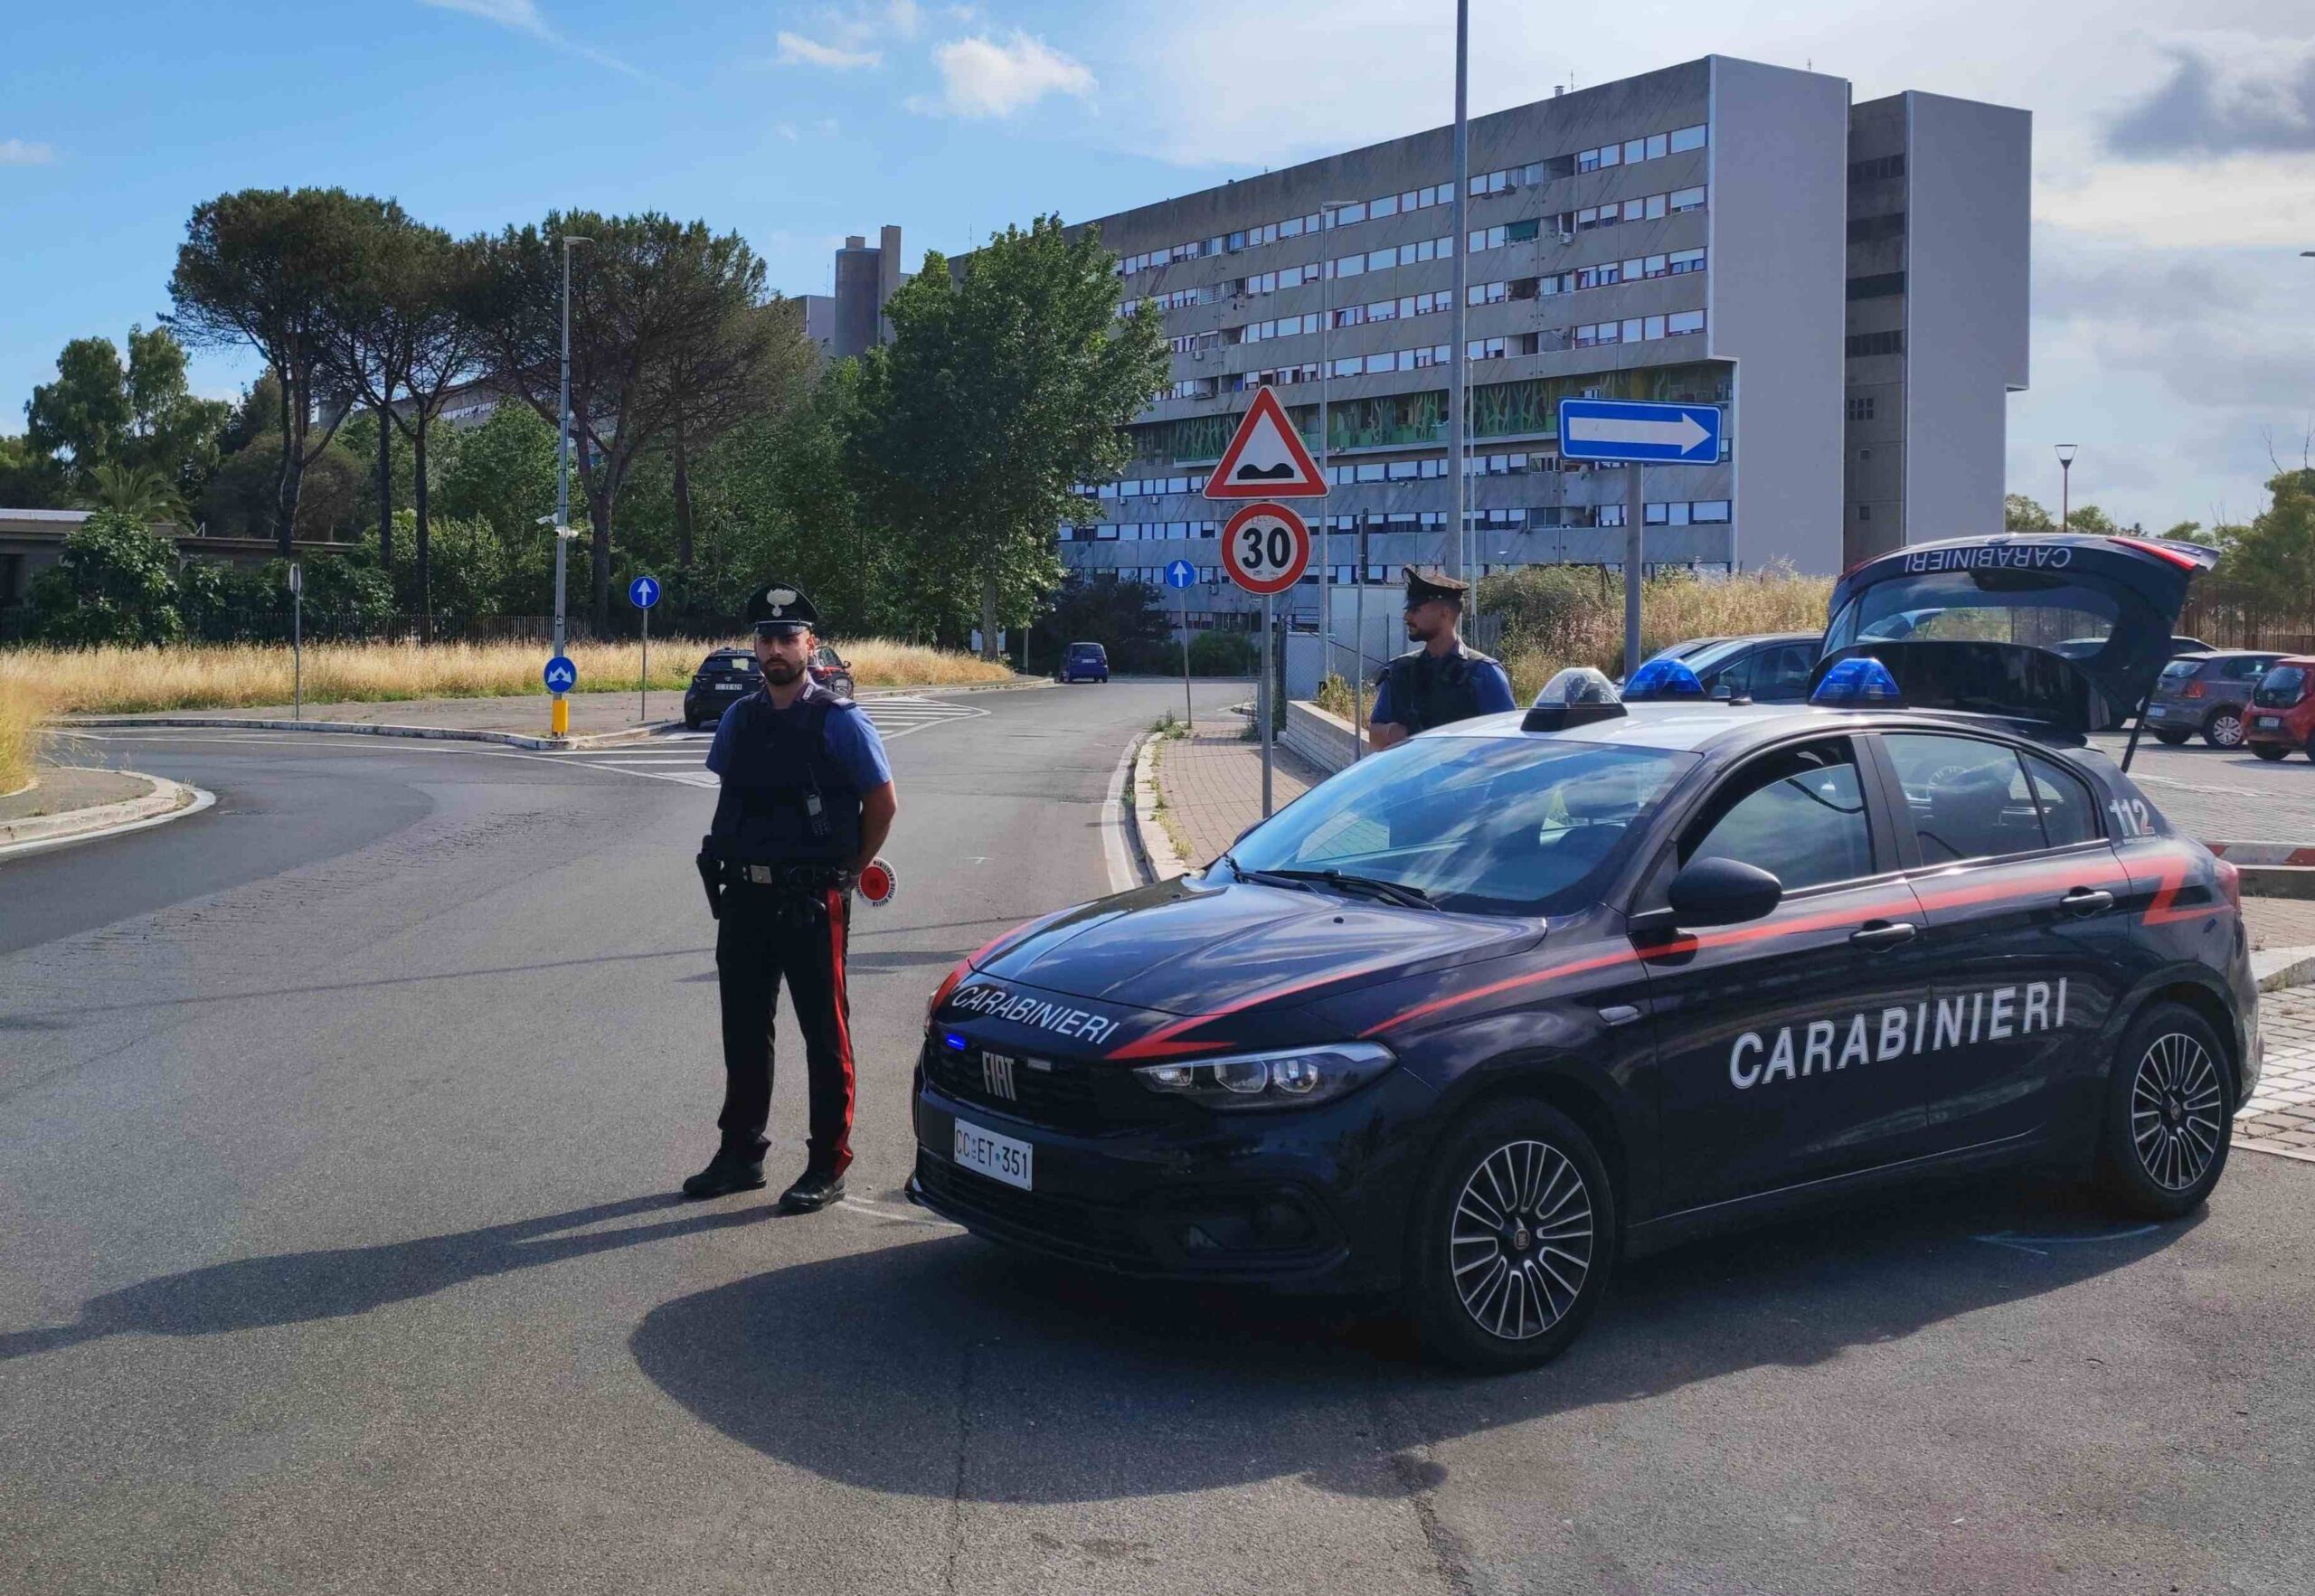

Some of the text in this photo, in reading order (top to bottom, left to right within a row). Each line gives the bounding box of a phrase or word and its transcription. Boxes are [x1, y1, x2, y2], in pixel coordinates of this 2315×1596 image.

[1242, 526, 1290, 569] 30
[1905, 547, 2072, 573] CARABINIERI
[2109, 798, 2156, 836] 112
[951, 986, 1120, 1044] CARABINIERI
[1729, 977, 2067, 1090] CARABINIERI
[982, 1051, 1017, 1101] FIAT
